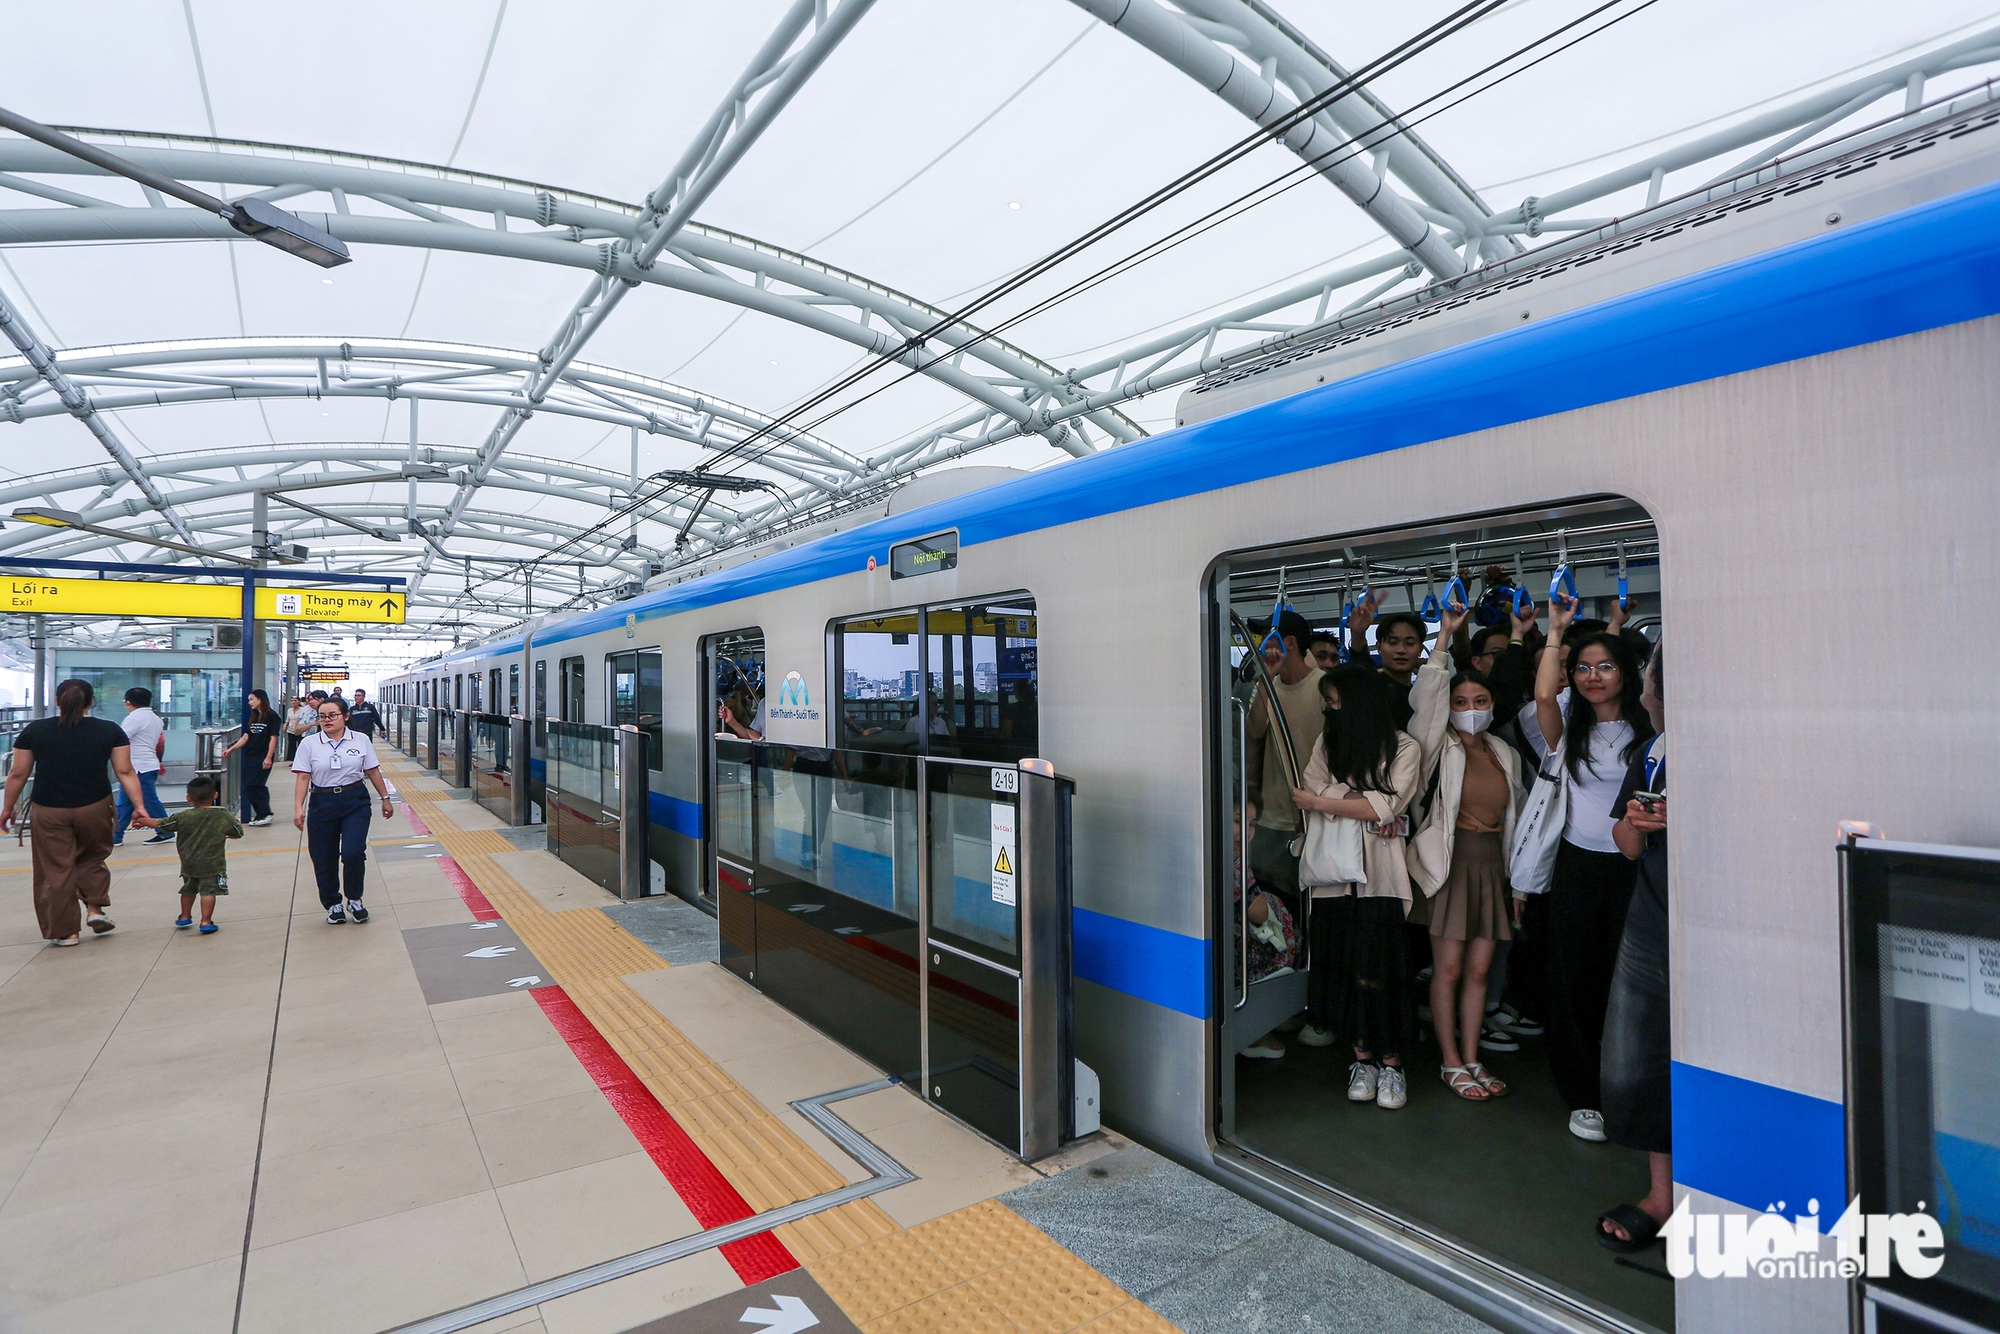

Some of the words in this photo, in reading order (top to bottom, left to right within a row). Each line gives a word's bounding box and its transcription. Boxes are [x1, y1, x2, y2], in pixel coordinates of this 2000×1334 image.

[12, 581, 36, 595] Lối
[41, 584, 58, 596] ra
[12, 597, 33, 607] Exit
[305, 594, 344, 608] Thang
[347, 596, 374, 609] máy
[305, 608, 340, 617] Elevator
[771, 708, 779, 718] Bến
[994, 771, 1014, 790] 2-19
[1918, 947, 1939, 957] Vào
